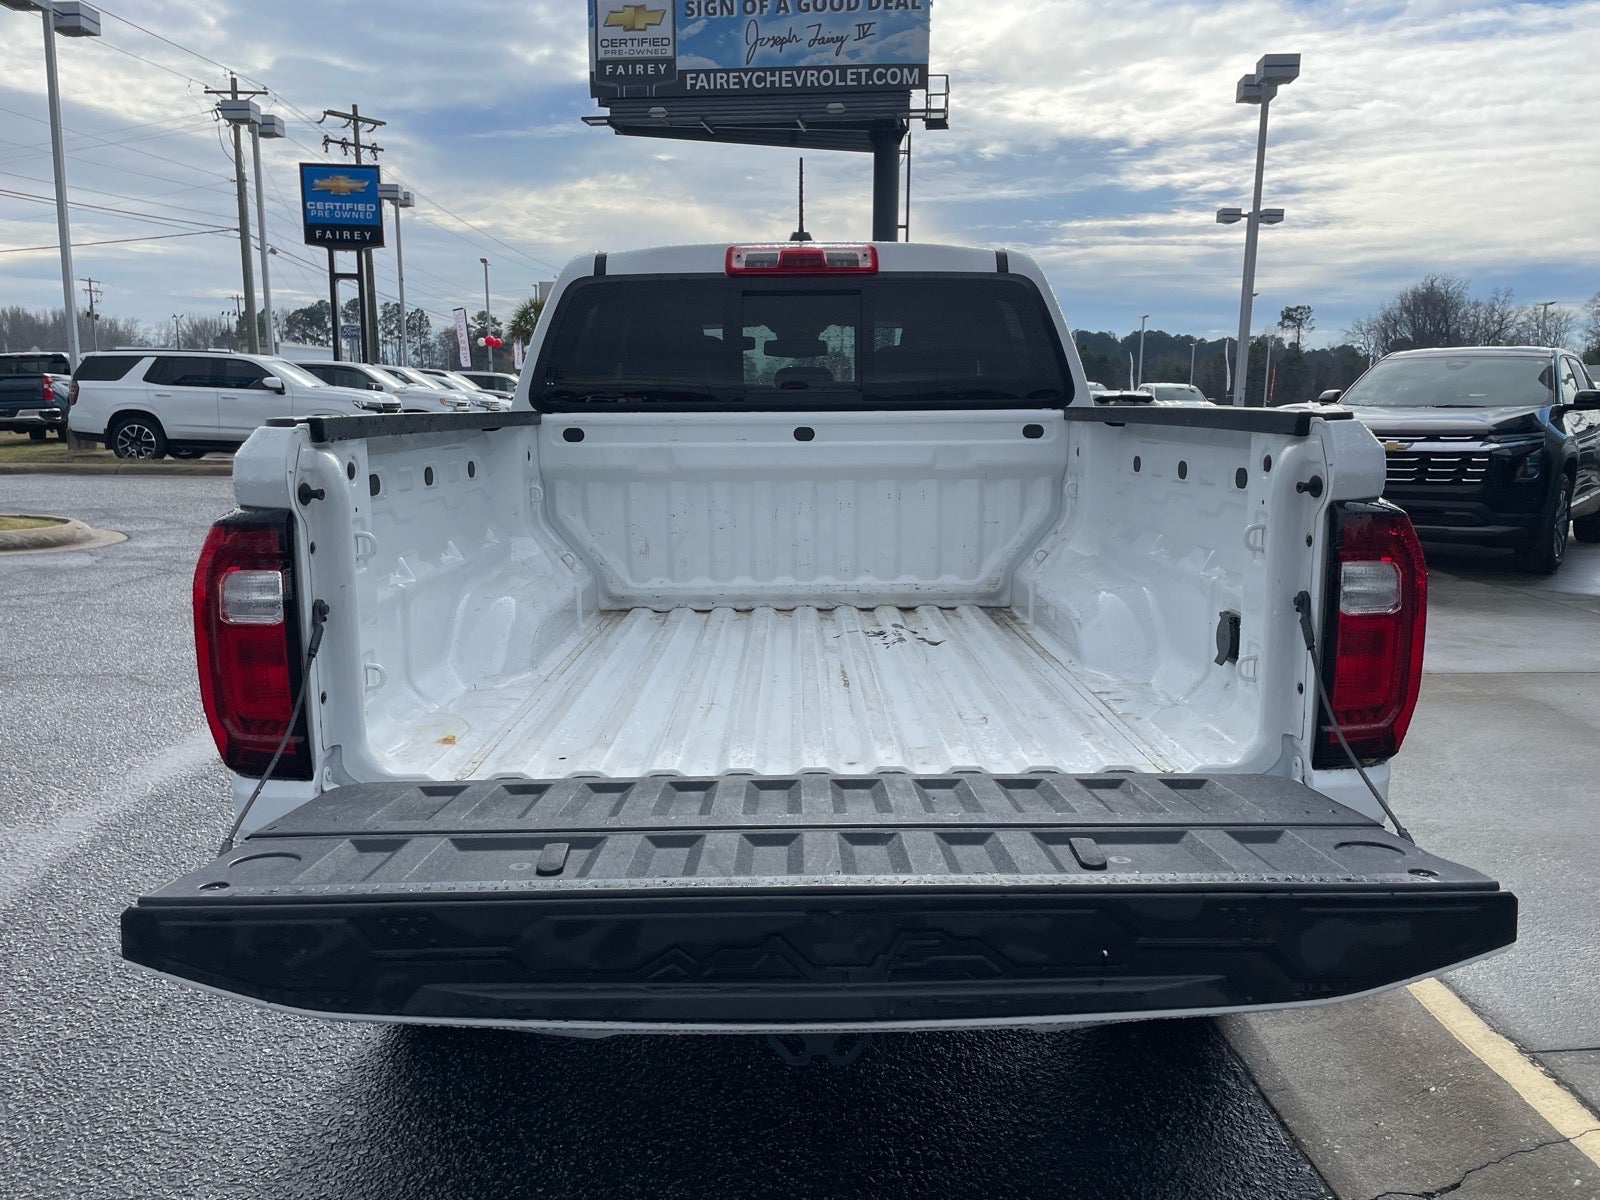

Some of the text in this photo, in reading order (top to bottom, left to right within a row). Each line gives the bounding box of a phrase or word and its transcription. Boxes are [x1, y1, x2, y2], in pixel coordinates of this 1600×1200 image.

[684, 0, 922, 17] SIGN OF A GOOD DEAL
[600, 37, 671, 48] CERTIFIED
[745, 19, 802, 65] Joseph
[853, 21, 877, 41] IV
[604, 48, 667, 56] PRE-OWNED
[605, 63, 667, 76] FAIREY
[685, 67, 920, 90] FAIREYCHEVROLET.COM
[306, 201, 376, 212] CERTIFIED
[310, 210, 373, 219] PRE-OWNED
[315, 230, 372, 240] FAIREY
